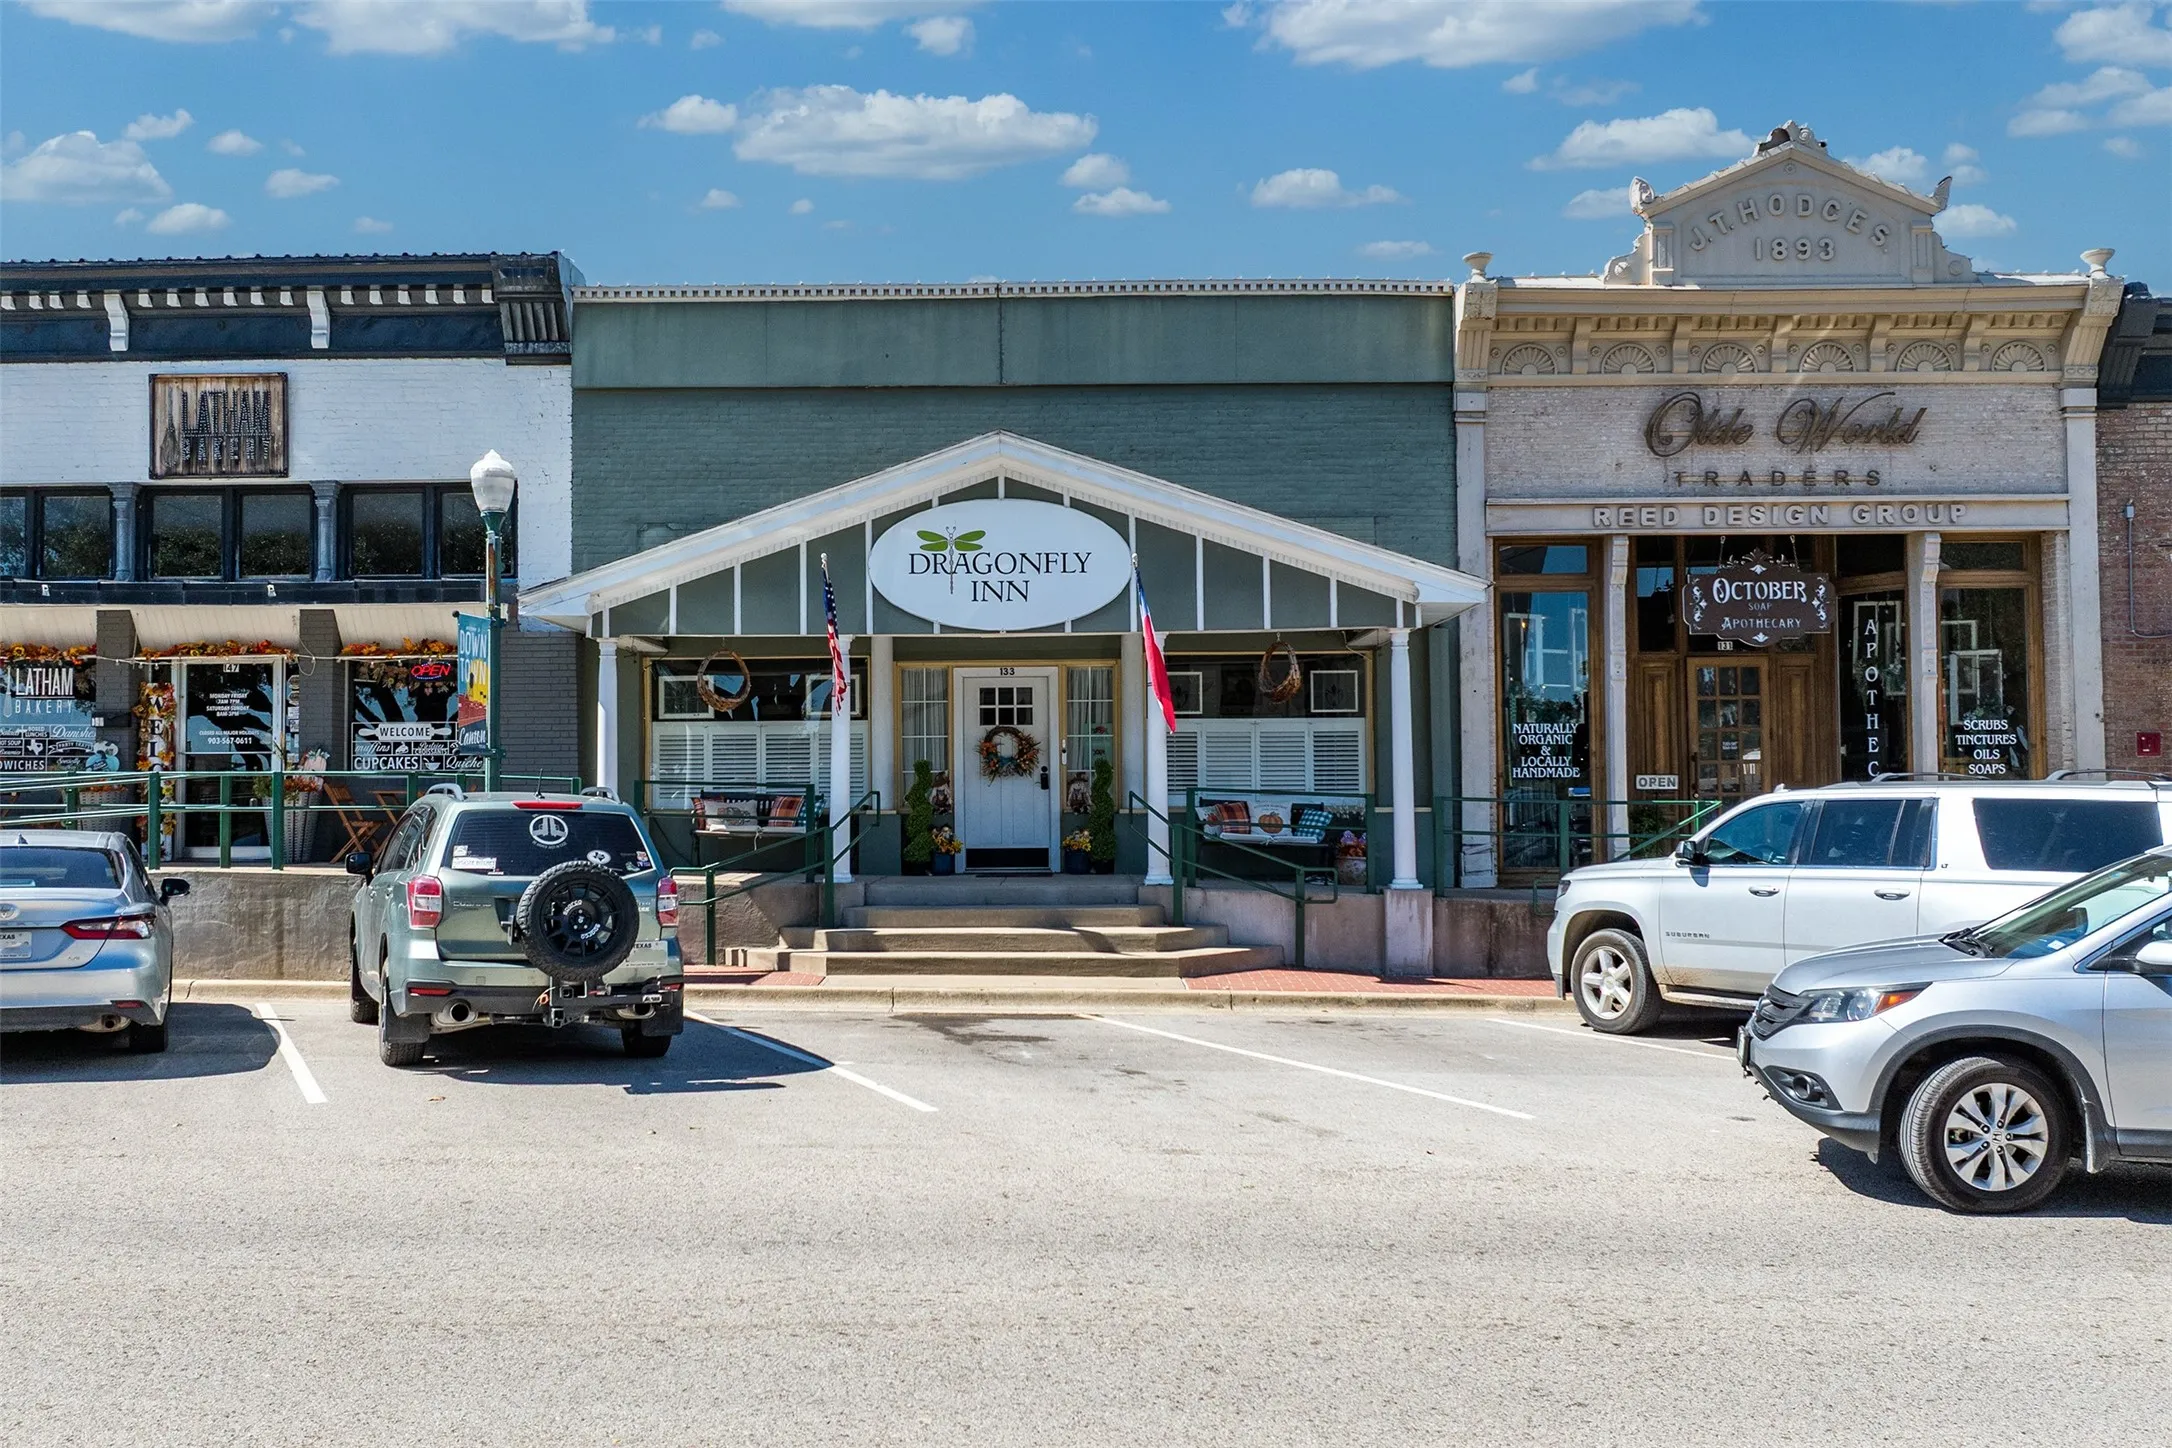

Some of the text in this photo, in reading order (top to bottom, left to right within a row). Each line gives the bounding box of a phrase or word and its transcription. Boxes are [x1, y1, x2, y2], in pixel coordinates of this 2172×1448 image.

[1754, 237, 1836, 261] 1893
[181, 389, 271, 434] LATHAM
[1644, 391, 1928, 457] Olde World
[1673, 470, 1881, 487] TRADERS
[1592, 503, 1968, 527] REED DESIGN GROUP
[908, 551, 1092, 575] DRAGONFLY
[971, 579, 1030, 602] INN
[1712, 577, 1807, 603] OCTOBER
[1748, 602, 1773, 611] SOAP
[1721, 617, 1802, 630] APOTHECARY
[459, 629, 487, 658] DOWN
[410, 664, 451, 676] OPEN
[459, 657, 487, 685] TOWN
[1000, 667, 1015, 676] 133
[15, 667, 74, 695] LATHAM
[1864, 619, 1880, 777] APOTHEC
[15, 700, 73, 713] BAKERY
[1513, 723, 1579, 734] NATURALLY
[1963, 719, 2009, 730] SCRUBS
[380, 727, 431, 737] WELCOME
[458, 727, 486, 746] Canton
[208, 737, 252, 745] 903-567-0611
[1519, 734, 1573, 745] ORGANIC
[1955, 734, 2017, 745] TINCTURES
[355, 741, 391, 752] muffins
[1540, 745, 1551, 756] &
[1973, 749, 2001, 760] OILS
[354, 757, 418, 770] CUPCAKES
[446, 755, 484, 769] Quiche
[1521, 756, 1573, 767] LOCALLY
[1512, 767, 1581, 778] HANDMADE
[1968, 764, 2006, 775] SOAPS
[1638, 777, 1677, 788] OPEN
[1665, 931, 1710, 939] SUBURBAN
